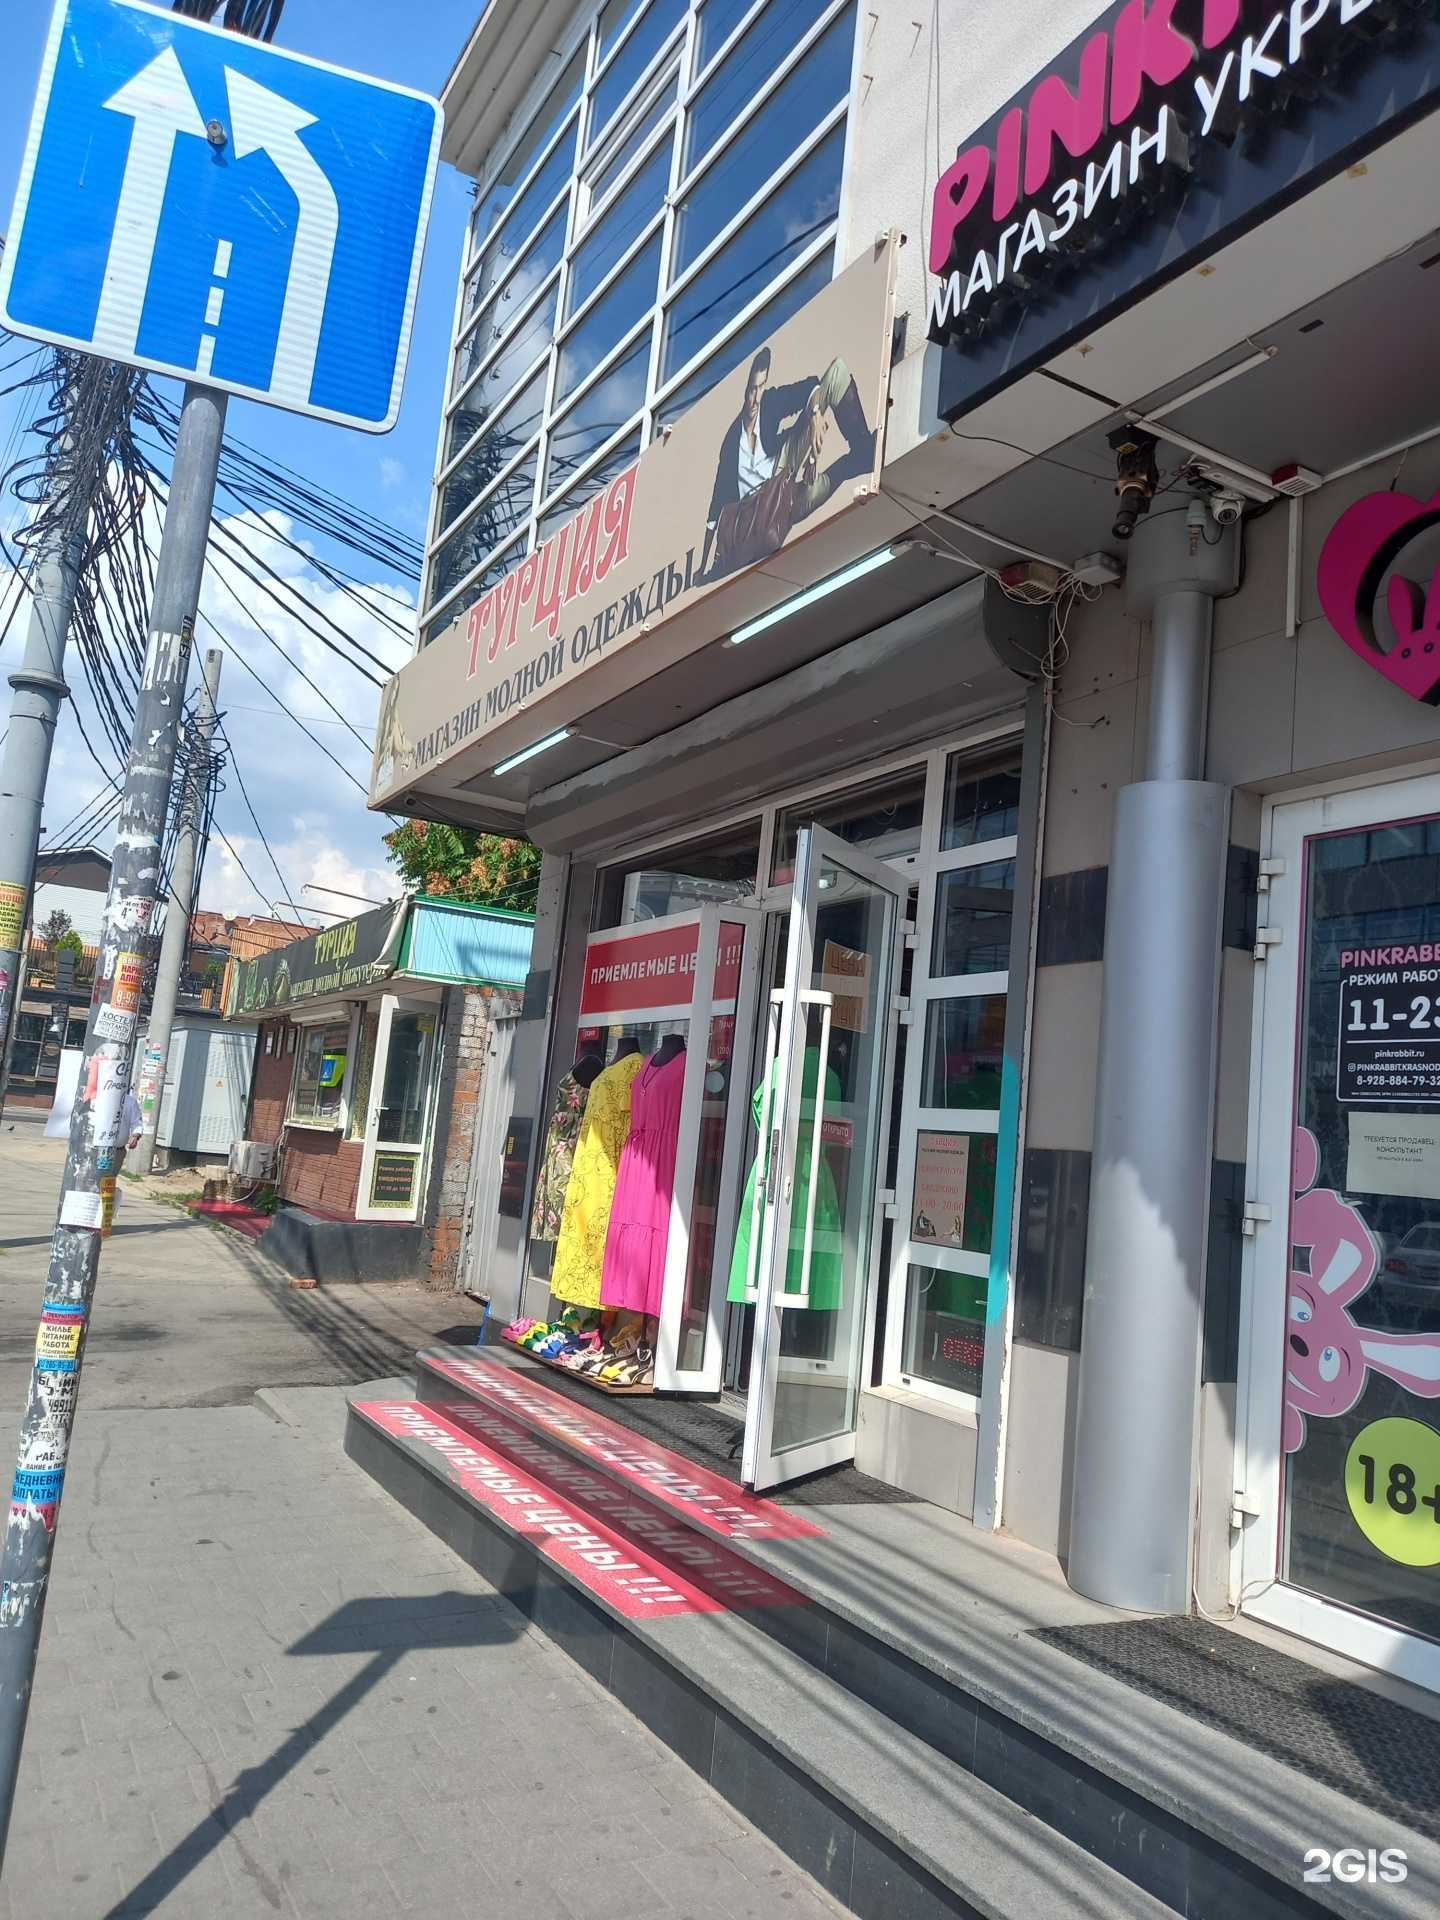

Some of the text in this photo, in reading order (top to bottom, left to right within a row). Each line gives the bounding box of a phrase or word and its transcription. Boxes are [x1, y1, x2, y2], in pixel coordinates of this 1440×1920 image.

[929, 0, 1241, 274] PINK
[925, 104, 1169, 334] МАГАЗИН
[466, 457, 641, 681] ТУРЦИЯ
[415, 547, 696, 769] МАГАЗИН МОДНОЙ ОДЕЖДЫ
[314, 920, 359, 965] ТУРЦИЯ
[1341, 943, 1440, 968] PINKRABB
[590, 954, 677, 985] ПРИЕМЛЕМЫЕ
[1349, 972, 1398, 986] РЕЖИМ
[1357, 1063, 1440, 1071] PINKRABBIT.KRASNOD
[1376, 1146, 1424, 1154] КОНСУЛЬТАНТ
[41, 1333, 76, 1341] ПИТАНИЕ
[43, 1341, 71, 1349] РАБОТА
[441, 1362, 627, 1447] ПРИЕМЛЕМЫЕ
[601, 1450, 723, 1502] ЦЕНЫ
[380, 1405, 688, 1604] ПРИЕМЛЕМЫЕ ЦЕНЫ !!!
[1359, 1454, 1440, 1524] 18+
